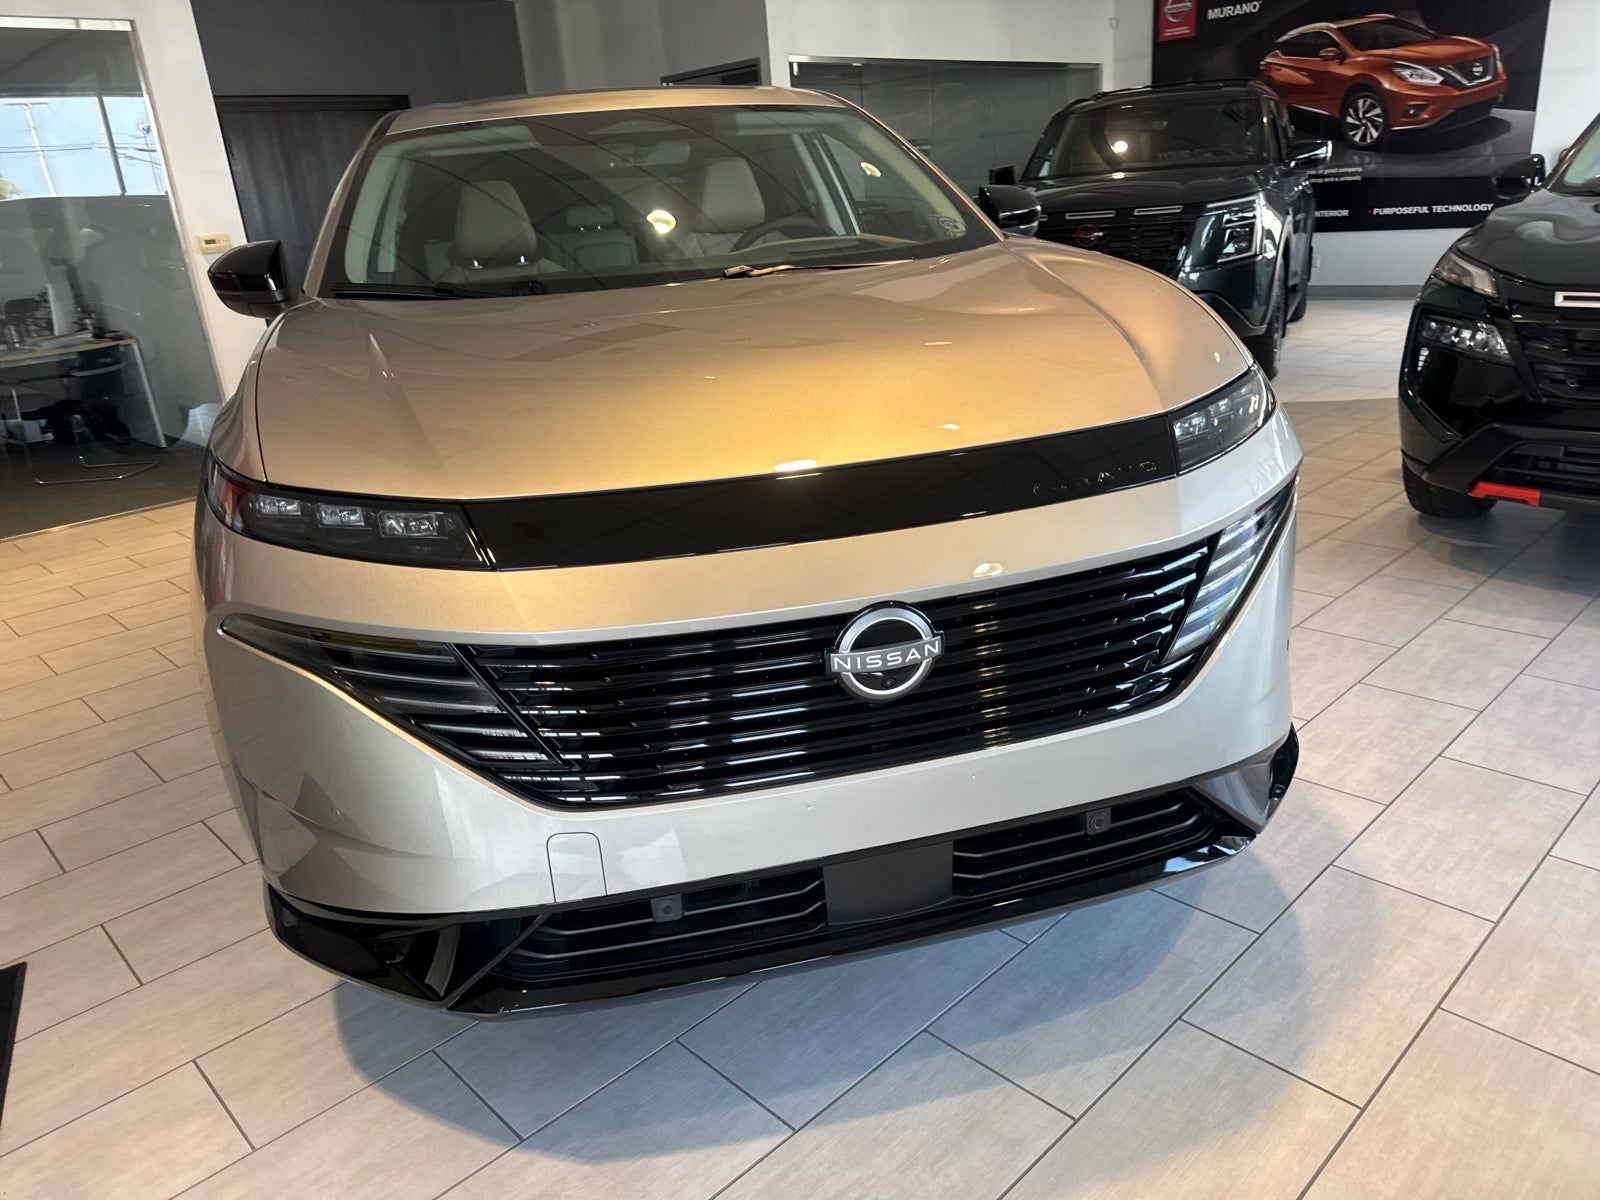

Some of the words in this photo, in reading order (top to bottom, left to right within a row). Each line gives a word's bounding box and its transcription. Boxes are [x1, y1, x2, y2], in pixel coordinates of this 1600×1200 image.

[1207, 1, 1260, 20] MURANO
[1314, 209, 1350, 218] NTERIOR
[1372, 206, 1430, 216] PURPOSEFUL
[1431, 203, 1494, 213] TECHNOLOGY
[833, 640, 939, 670] NISSAN
